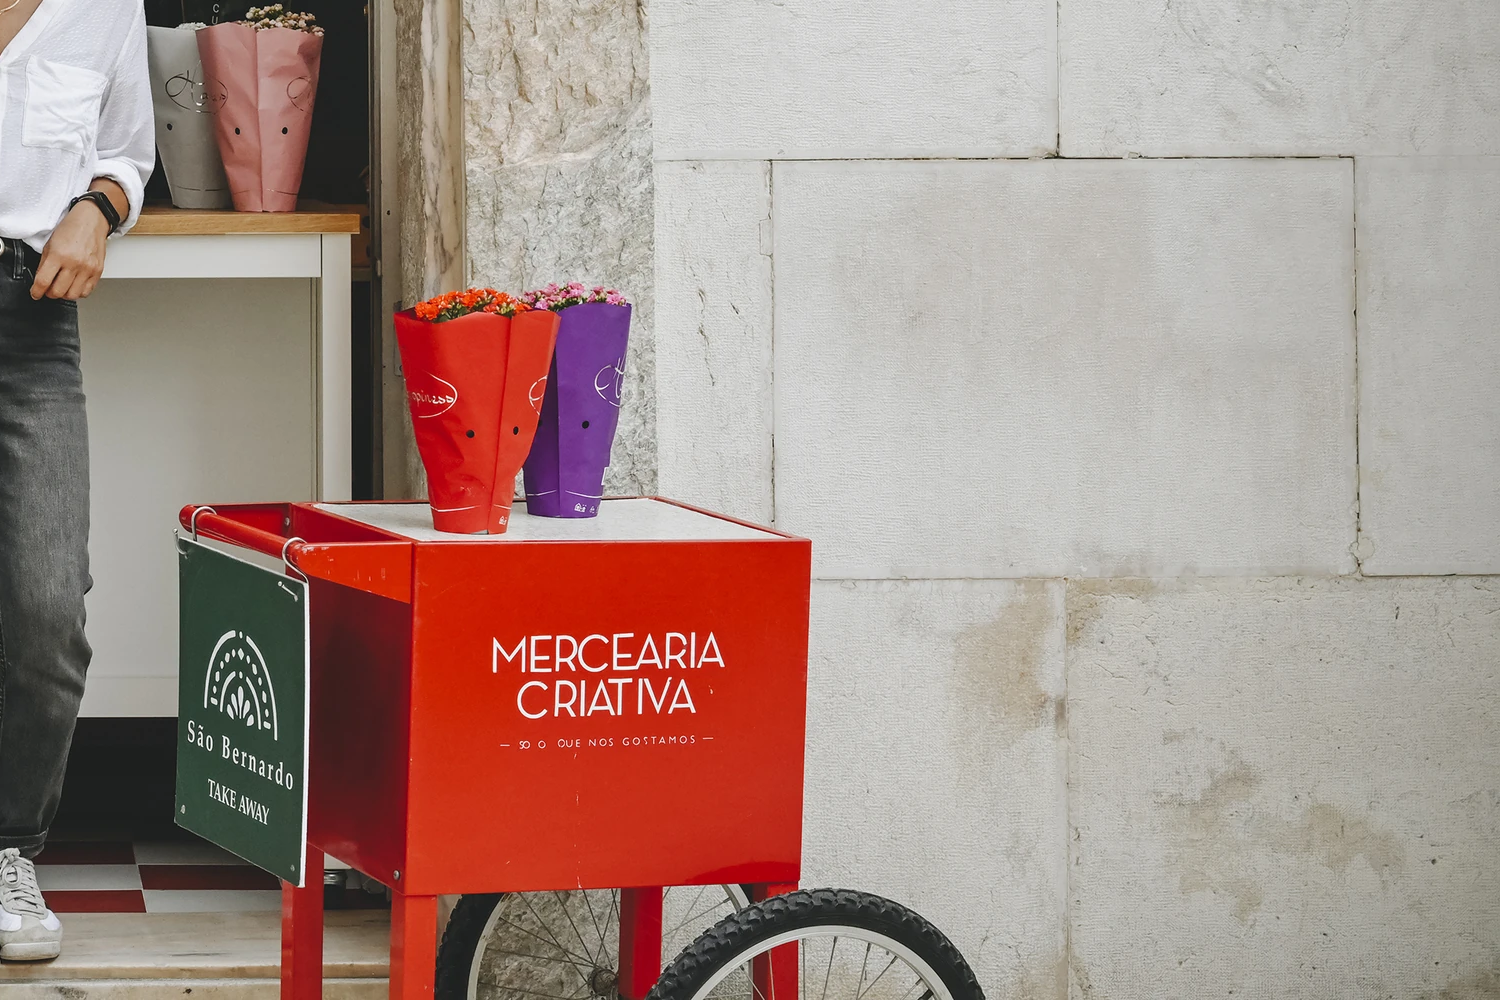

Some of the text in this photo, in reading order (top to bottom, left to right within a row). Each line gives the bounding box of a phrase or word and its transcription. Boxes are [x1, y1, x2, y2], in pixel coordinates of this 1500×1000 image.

[492, 631, 725, 673] MERCEARIA
[516, 676, 696, 719] CRIATIVA
[187, 720, 293, 789] São Bernardo
[537, 739, 546, 749] O
[622, 735, 696, 747] GOSTAMOS
[207, 778, 270, 825] TAKE AWAY
